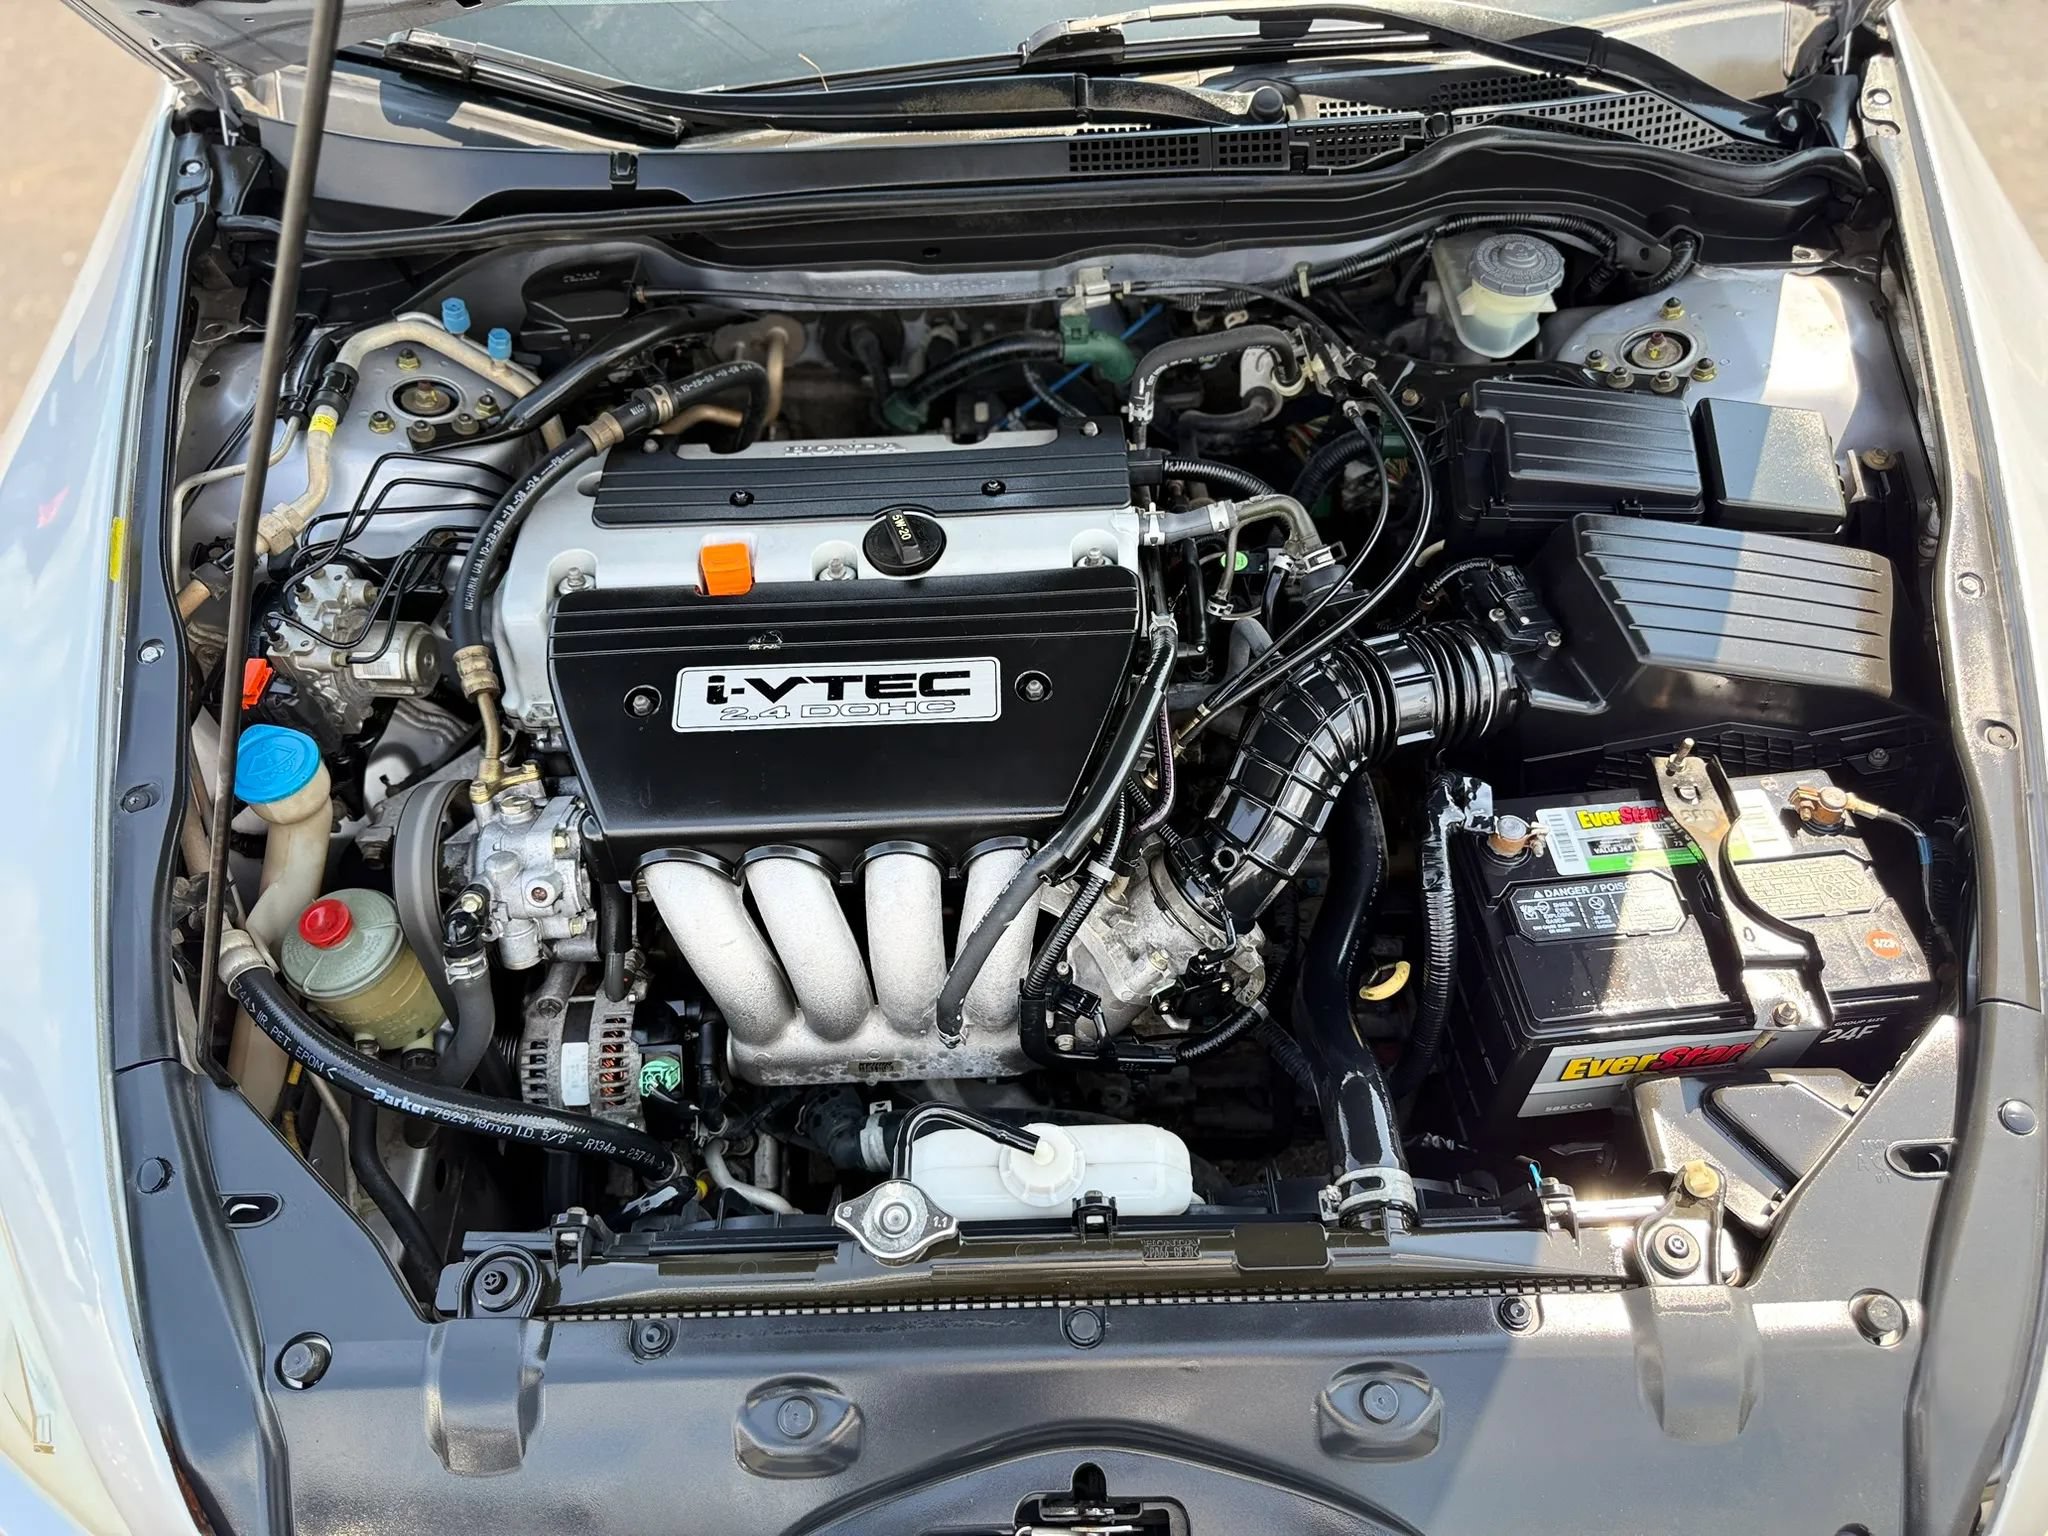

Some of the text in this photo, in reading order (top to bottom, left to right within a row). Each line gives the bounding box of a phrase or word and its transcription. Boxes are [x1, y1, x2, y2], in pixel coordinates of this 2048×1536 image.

[784, 442, 907, 457] HONDA
[892, 514, 912, 540] 5W-20
[706, 671, 971, 706] i-VTEC
[720, 700, 957, 722] 2.4 DOHC
[1576, 807, 1667, 829] EverStar
[1544, 886, 1590, 898] DANGER
[1834, 1019, 1867, 1027] GROUP
[1819, 1024, 1881, 1044] 24F
[1560, 1043, 1757, 1082] EverStar
[1570, 1102, 1593, 1110] CCA
[372, 1086, 429, 1116] Parker
[516, 1125, 536, 1140] I.D.
[584, 1138, 616, 1155] R134a
[932, 1216, 948, 1228] 1.1
